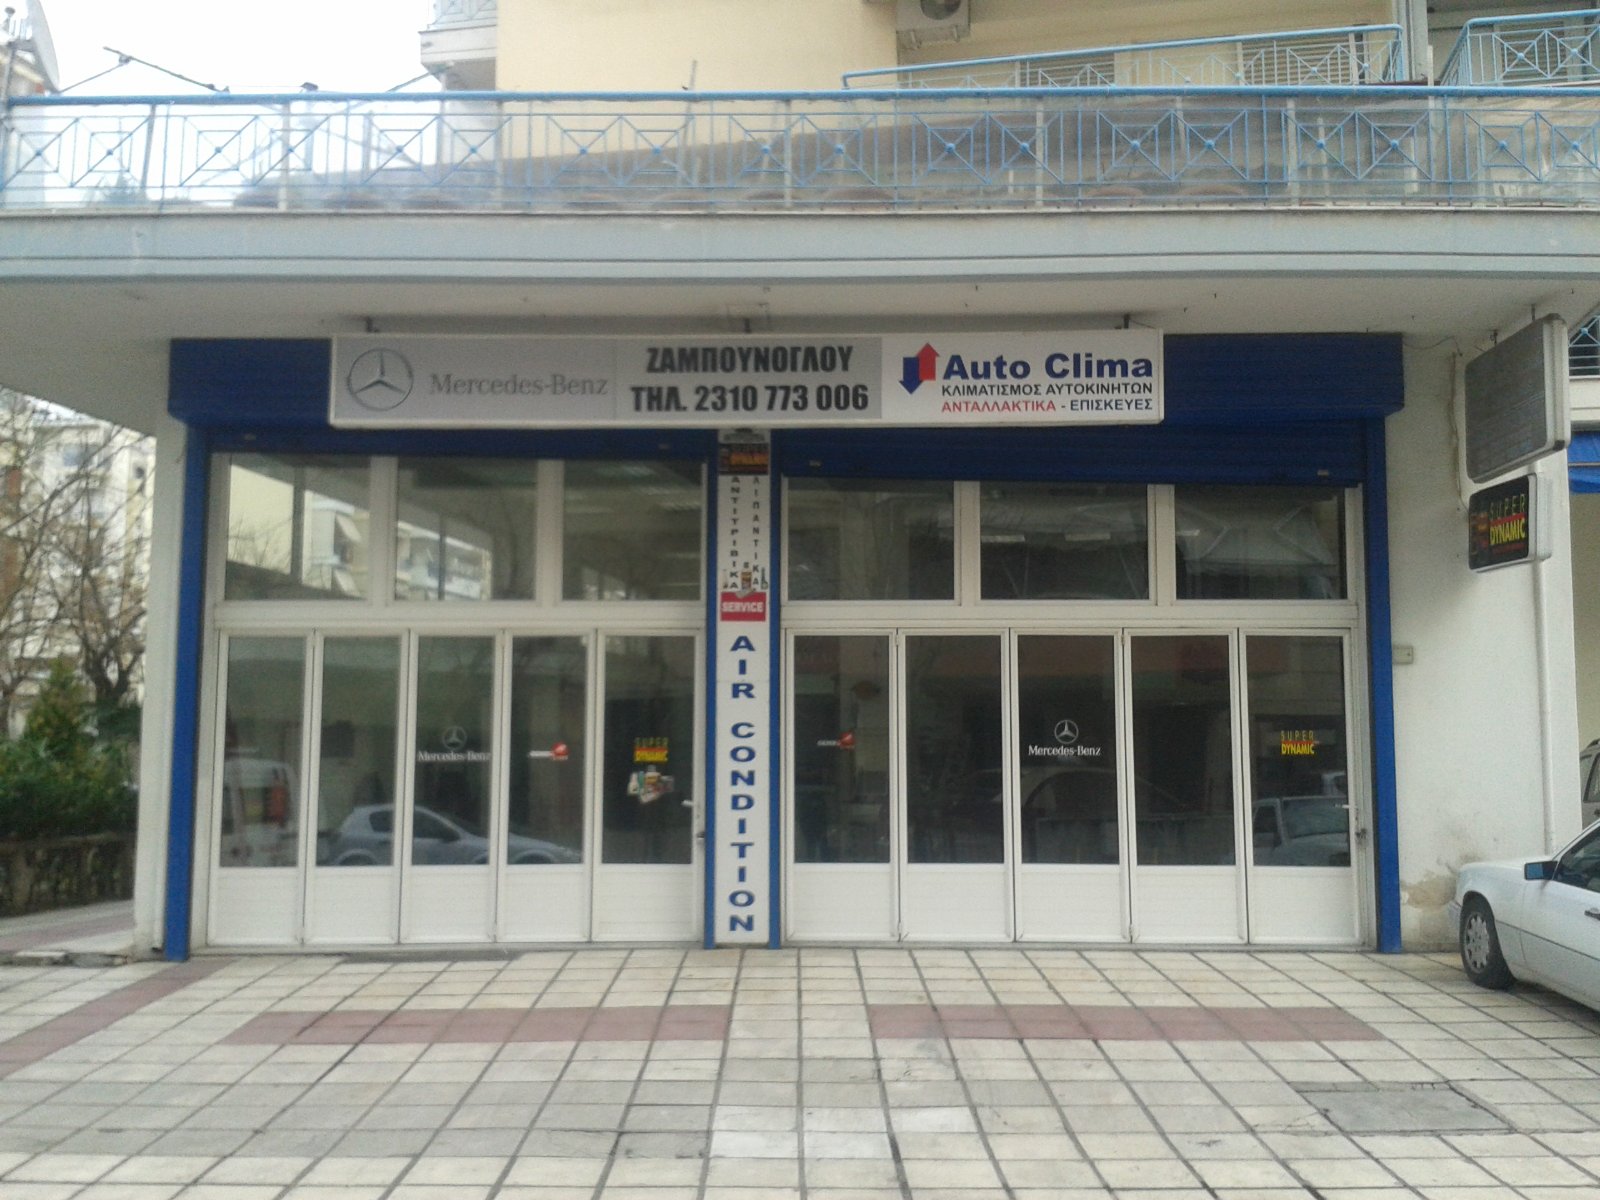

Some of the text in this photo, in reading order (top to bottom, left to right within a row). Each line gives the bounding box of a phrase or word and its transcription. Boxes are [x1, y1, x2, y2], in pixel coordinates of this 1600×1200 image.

[646, 345, 854, 374] ΖΑΜΠΟΥΝΟΓΛΟΥ
[942, 352, 1153, 380] Auto Clima
[429, 372, 608, 397] Mercedes-Benz
[941, 381, 1153, 396] ΚΛΙΜΑΤΙΣΜΟΣ ΑΥΤΟΚΙΝΗΤΩΝ
[631, 384, 869, 412] ΤΗΛ. 2310 773 006
[941, 400, 1056, 413] ΑΝΤΑΛΛΑΚΤΙΚΑ
[1069, 399, 1153, 411] ΕΠΙΣΚΕΥΕΣ
[1489, 493, 1525, 521] SUPER
[1489, 517, 1526, 546] DYNAMIC
[722, 601, 764, 613] SERVICE
[1280, 730, 1314, 741] SUPER
[418, 750, 490, 762] Mercedes-Benz
[1028, 744, 1101, 757] Mercedes-Benz
[1281, 743, 1315, 755] DYNAMIC
[729, 635, 756, 932] AIR CONDITION
